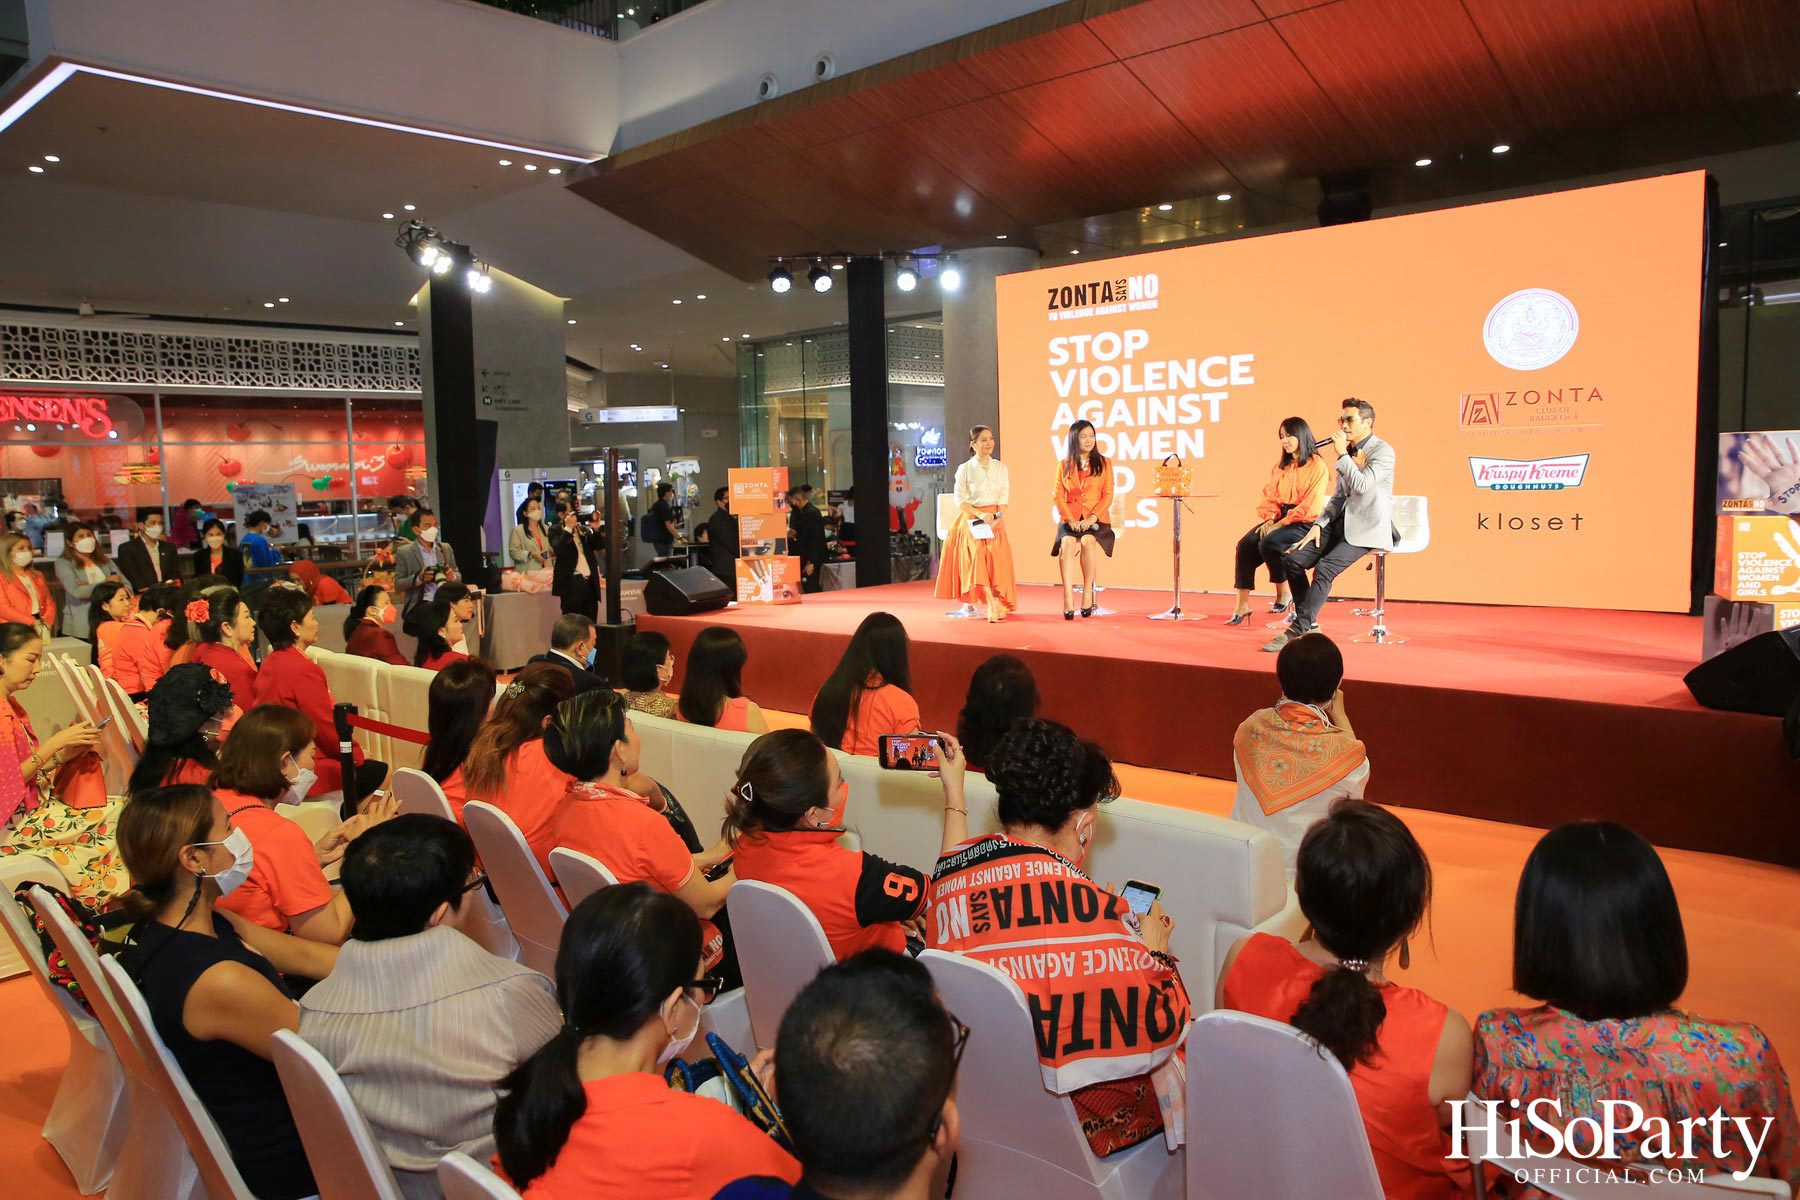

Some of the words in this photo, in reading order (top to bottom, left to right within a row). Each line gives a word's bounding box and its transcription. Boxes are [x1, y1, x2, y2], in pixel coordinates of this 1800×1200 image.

[1048, 281, 1114, 310] ZONTA
[1116, 278, 1127, 302] SAYS
[1128, 273, 1159, 301] NO
[1048, 312, 1059, 321] TO
[1059, 307, 1095, 320] VIOLENCE
[1095, 303, 1127, 316] AGAINST
[1128, 300, 1158, 312] WOMEN
[1048, 329, 1149, 366] STOP
[1049, 354, 1254, 397] VIOLENCE
[1506, 387, 1603, 406] ZONTA
[585, 412, 593, 421] G
[1050, 392, 1229, 430] AGAINST
[504, 470, 511, 478] G
[1478, 464, 1530, 482] Krispy
[1529, 463, 1582, 480] Kreme
[1723, 500, 1749, 508] ZONTA
[1478, 513, 1584, 530] kloset
[1738, 559, 1792, 567] VIOLENCE
[1737, 588, 1767, 596] GIRLS
[970, 863, 1021, 888] AGAINST
[1025, 862, 1087, 880] OLENCE
[936, 877, 967, 899] WOMEN
[970, 890, 991, 934] SAYS
[990, 880, 1120, 930] ZONTA
[935, 894, 971, 945] NO
[1028, 980, 1187, 1061] ONTA
